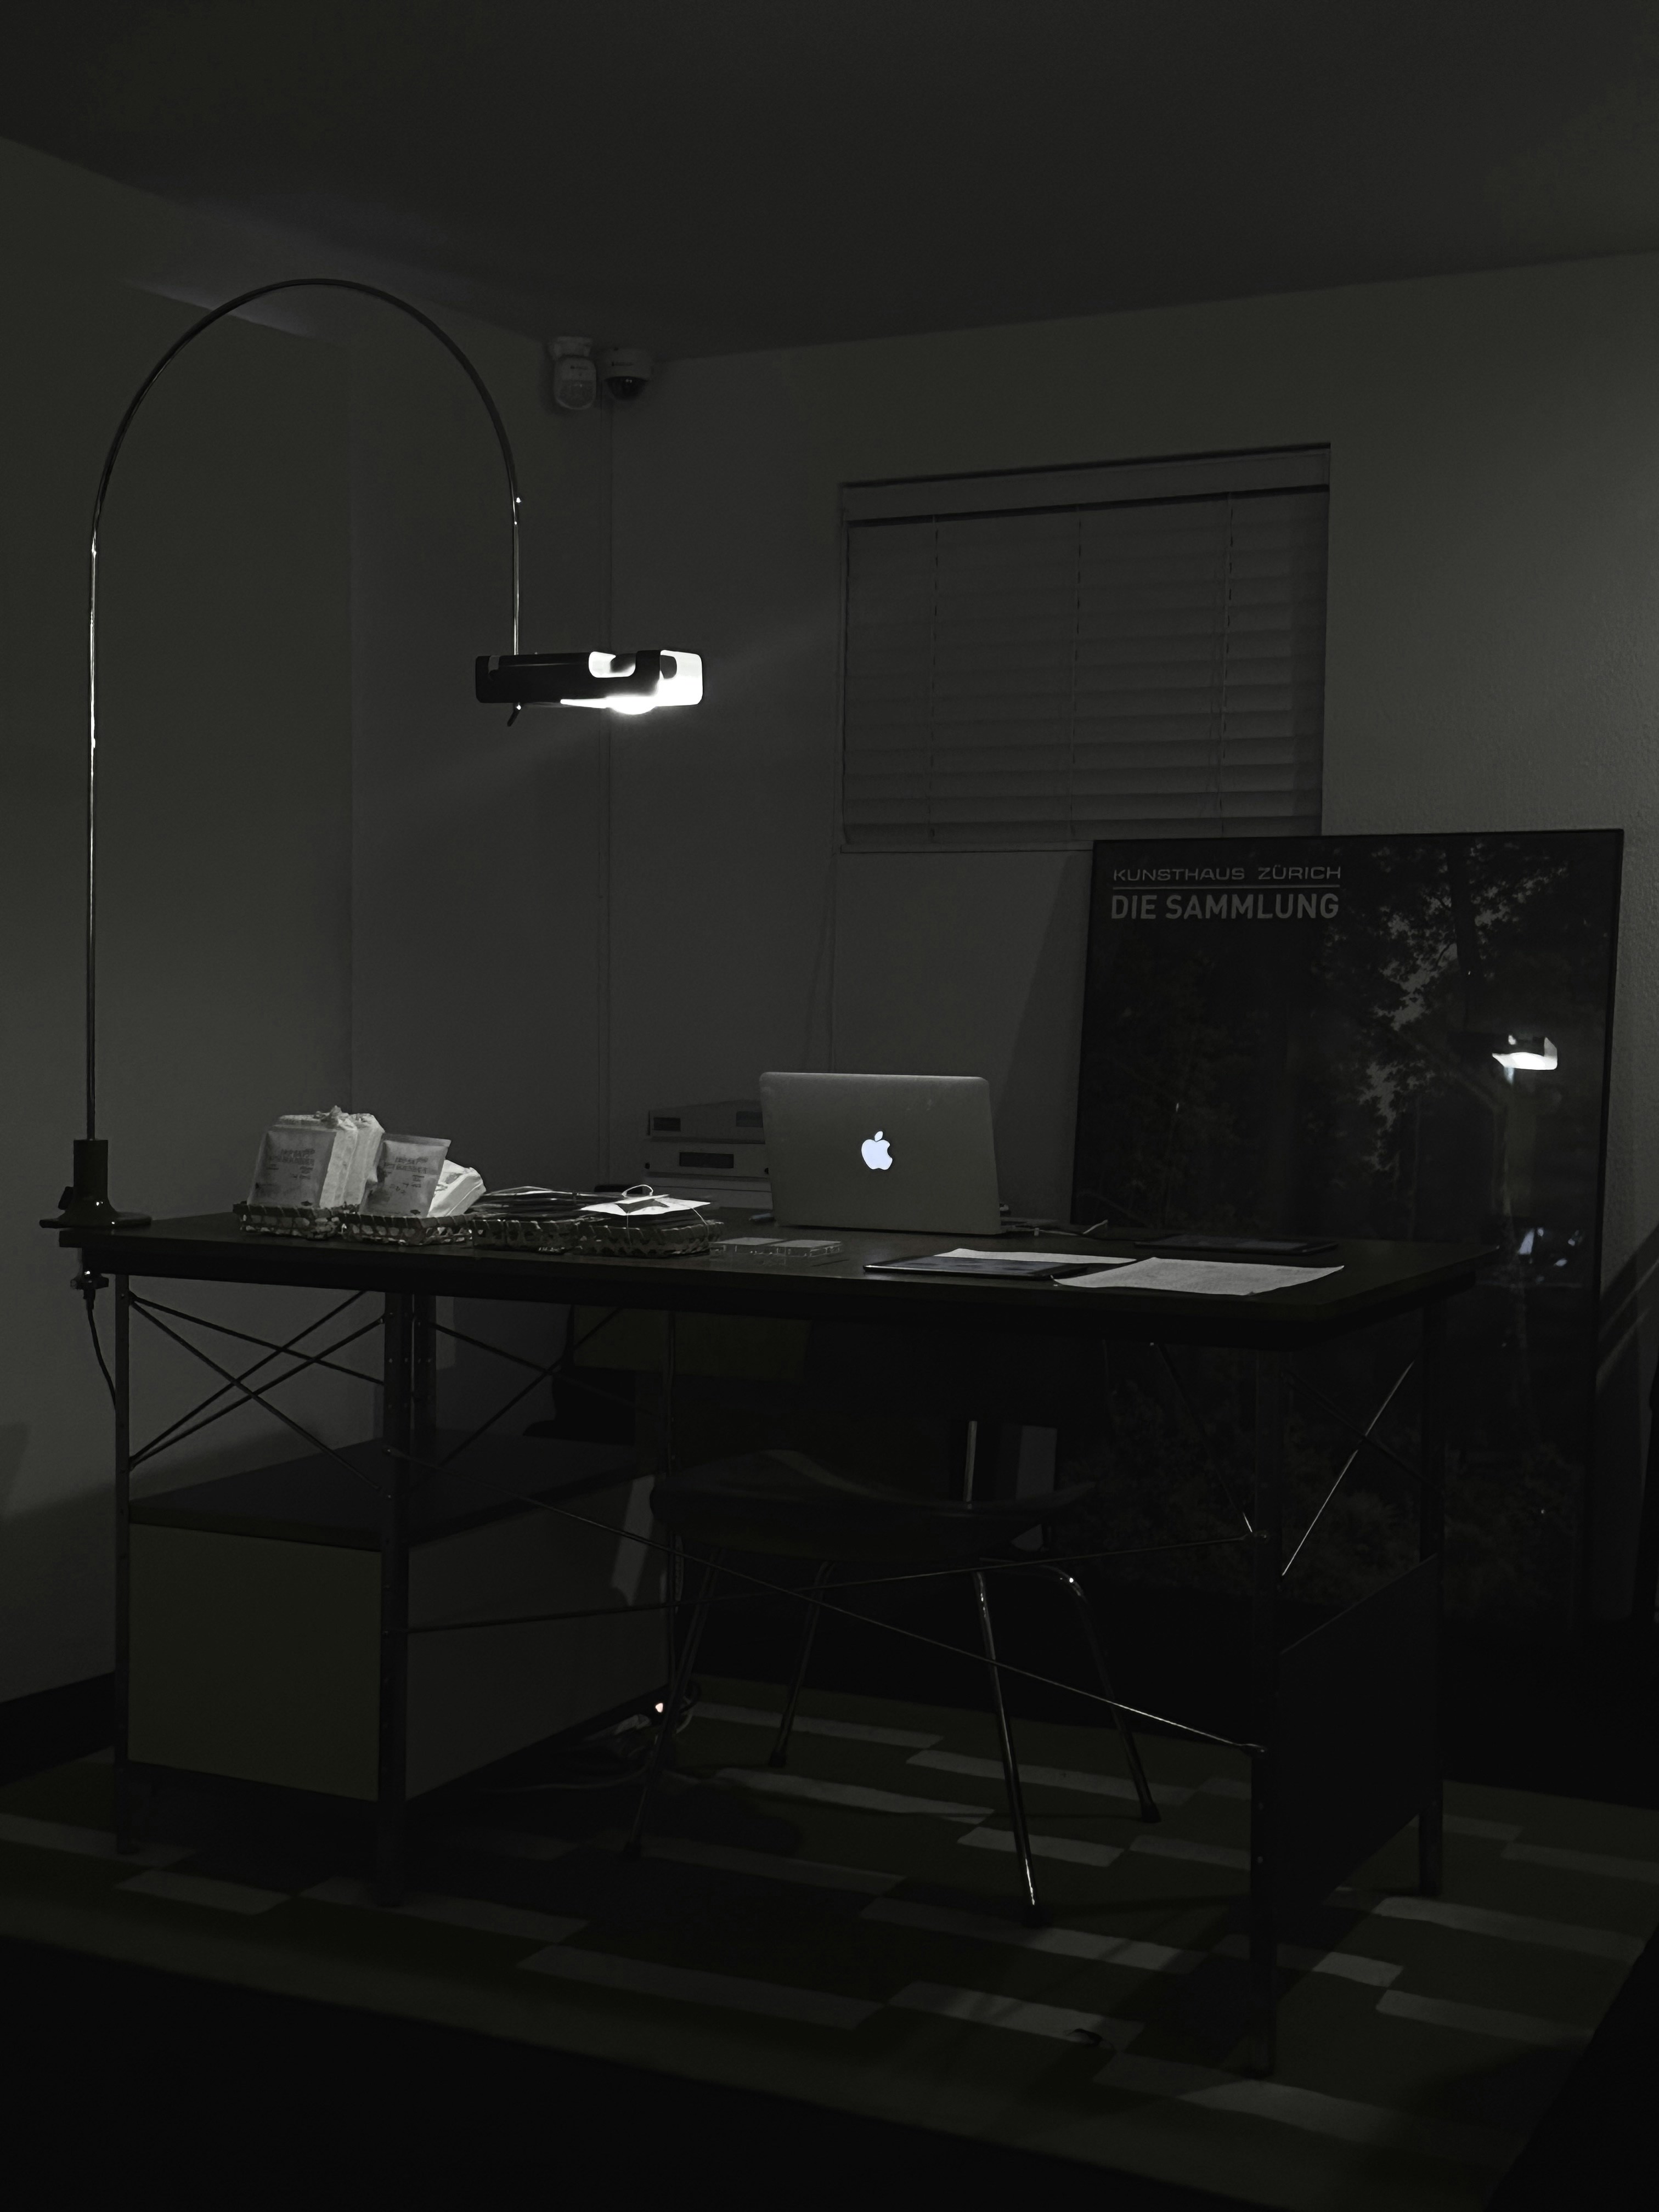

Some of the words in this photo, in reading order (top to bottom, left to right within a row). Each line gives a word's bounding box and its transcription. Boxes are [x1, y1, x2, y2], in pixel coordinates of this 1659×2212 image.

[1114, 868, 1245, 881] KUNSTHAUS
[1258, 865, 1341, 880] ZÜRICH
[1111, 895, 1157, 919] DIE
[1166, 893, 1339, 919] SAMMLUNG
